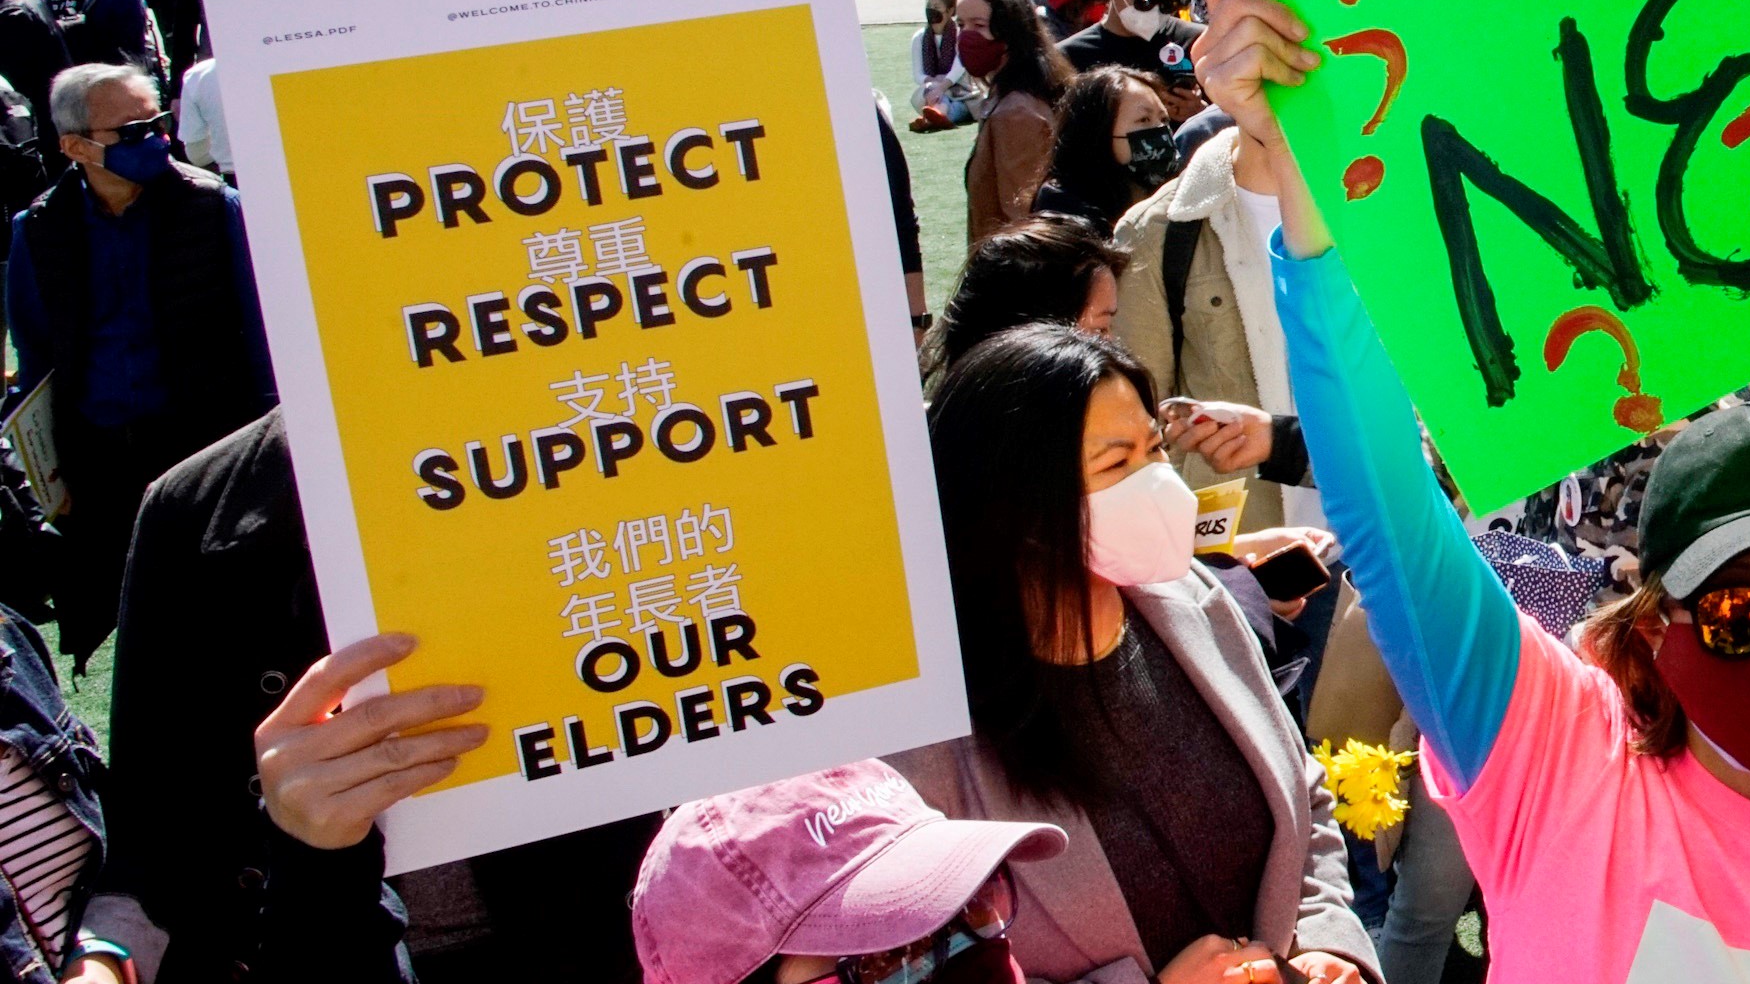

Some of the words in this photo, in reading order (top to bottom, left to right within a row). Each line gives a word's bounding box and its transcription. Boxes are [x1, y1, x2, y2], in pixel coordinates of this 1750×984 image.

[261, 24, 358, 47] @LESSA.PDF
[501, 86, 630, 158] 保護
[365, 118, 765, 239] PROTECT
[521, 216, 654, 285] 尊重
[402, 246, 777, 369] RESPECT
[549, 357, 677, 430] 支持
[411, 378, 819, 511] SUPPORT
[547, 503, 735, 589] 我們的
[560, 564, 744, 643] 年長者
[574, 608, 761, 694] OUR
[512, 661, 825, 783] ELDERS
